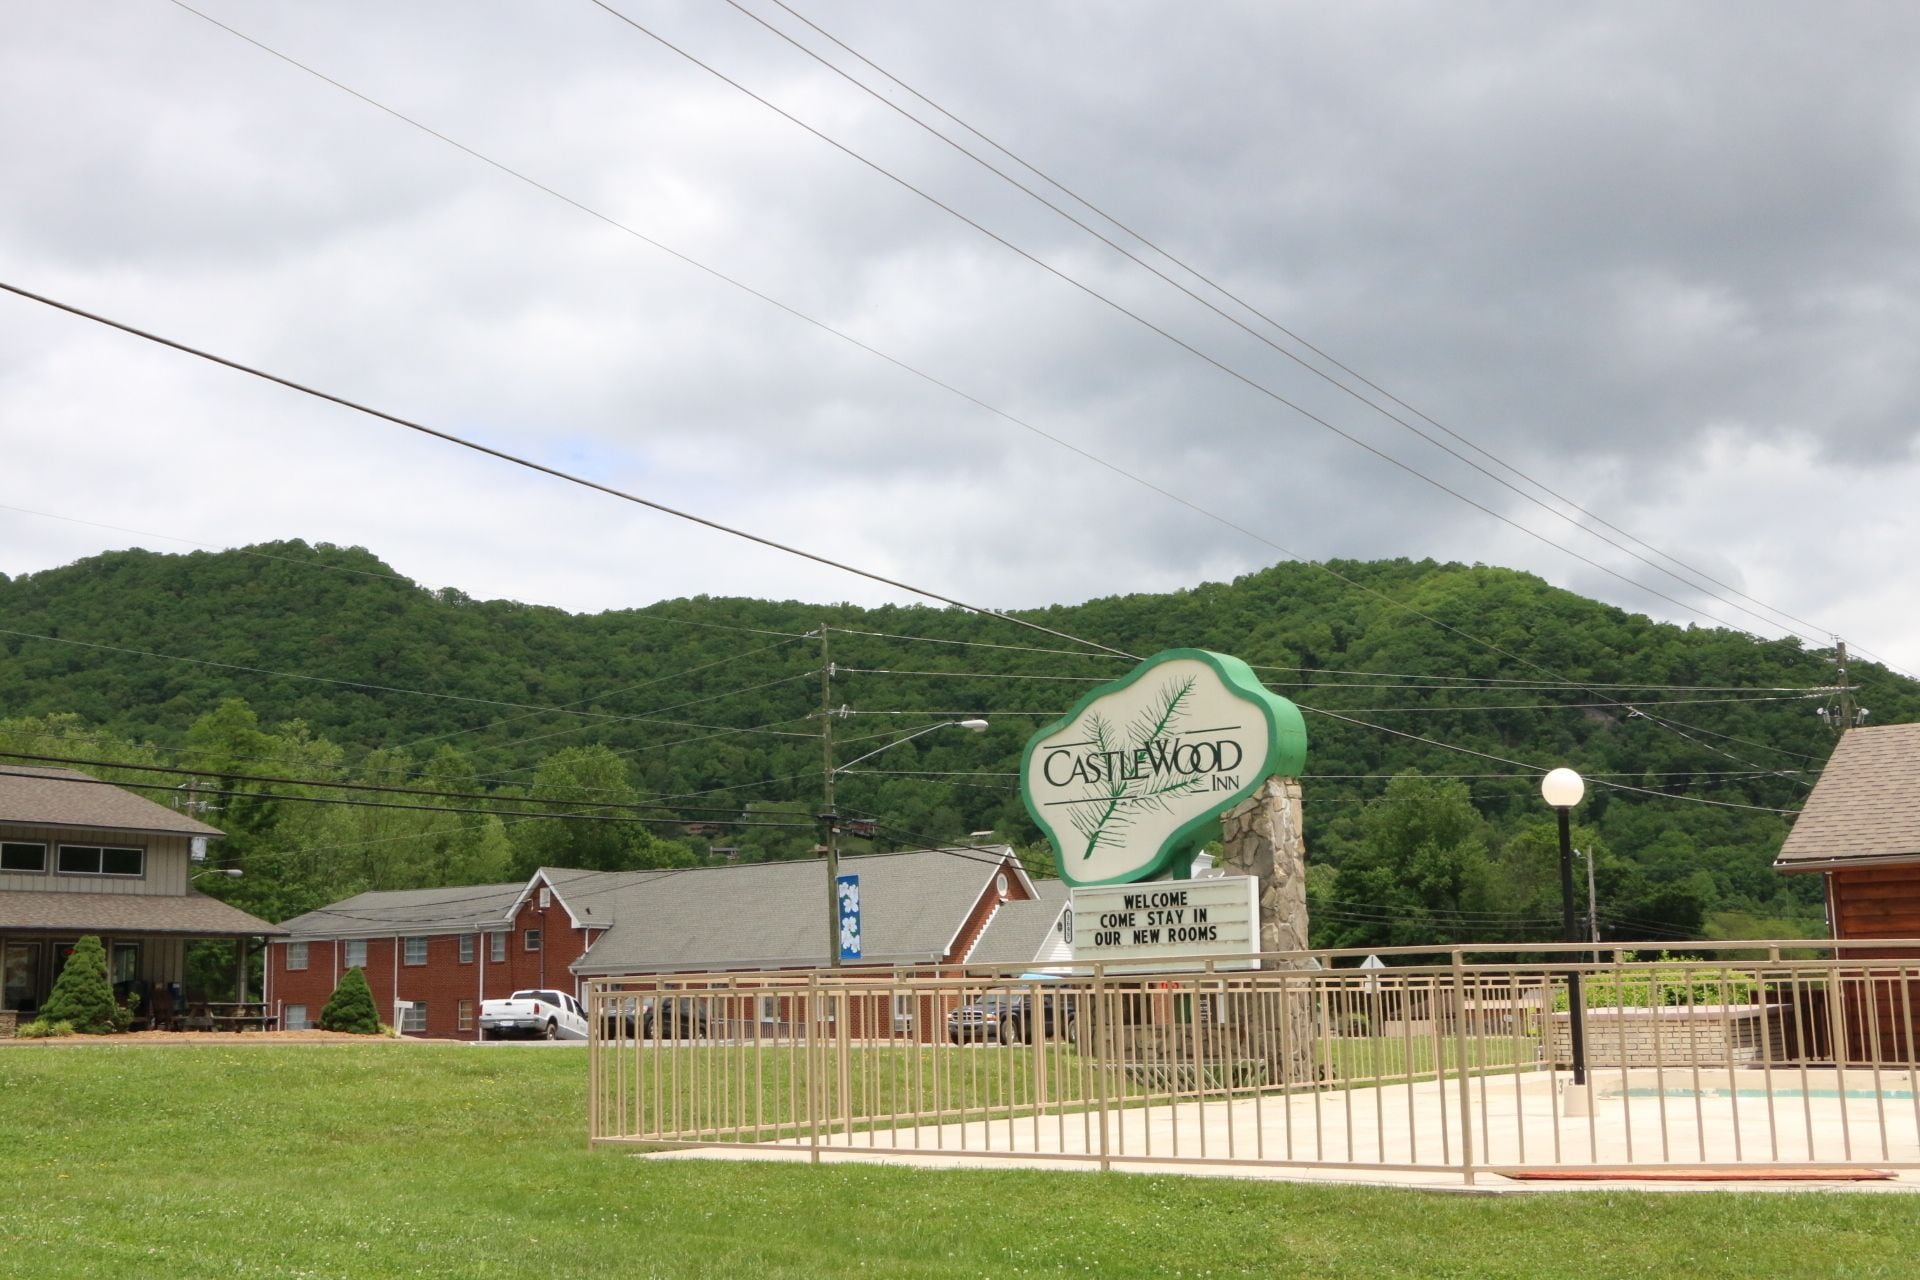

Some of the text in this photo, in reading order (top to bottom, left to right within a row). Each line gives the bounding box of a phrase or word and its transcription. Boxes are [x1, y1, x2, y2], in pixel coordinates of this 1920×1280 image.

[1212, 774, 1240, 792] INN
[1124, 891, 1188, 910] WELCOME
[1100, 908, 1207, 928] COME STAY IN
[1094, 925, 1217, 946] OUR NEW ROOMS
